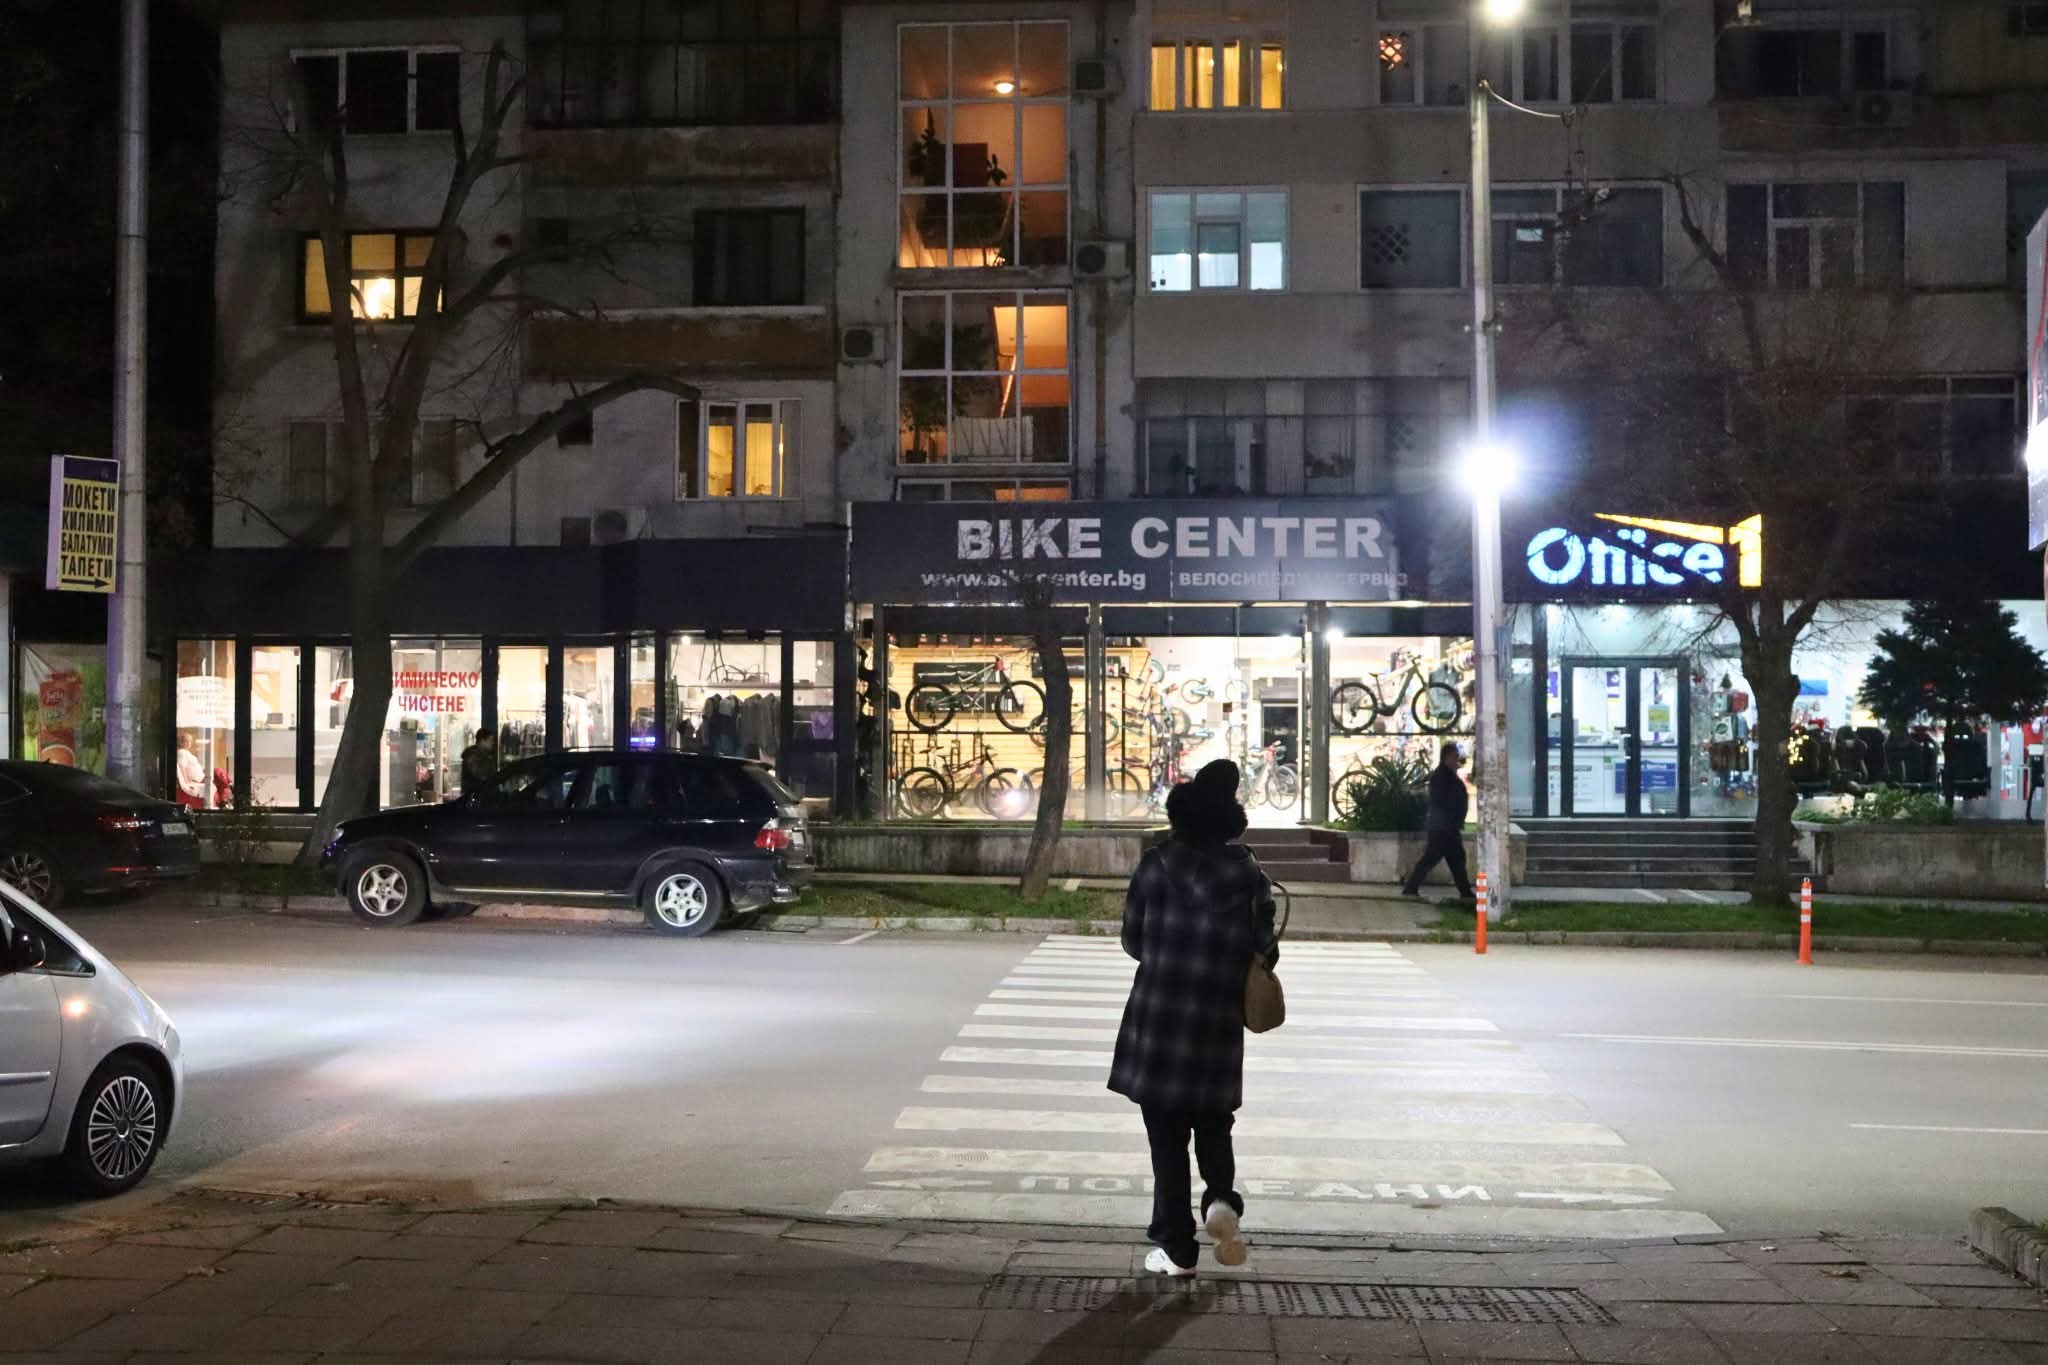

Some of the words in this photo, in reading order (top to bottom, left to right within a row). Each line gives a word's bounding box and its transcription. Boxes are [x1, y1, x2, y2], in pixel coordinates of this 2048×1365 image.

[63, 484, 116, 512] МОКЕТИ
[62, 511, 114, 534] КИЛИМИ
[61, 532, 113, 556] БАЛАТУМИ
[956, 518, 1102, 560] BIKE
[1130, 517, 1384, 560] CENTER
[1728, 513, 1763, 587] 1
[60, 555, 112, 578] ТАПЕТИ
[392, 671, 480, 689] ИМИЧЕСКО
[398, 695, 465, 713] ЧИСТЕНЕ
[1017, 1174, 1493, 1202] ПОЕДНИ
